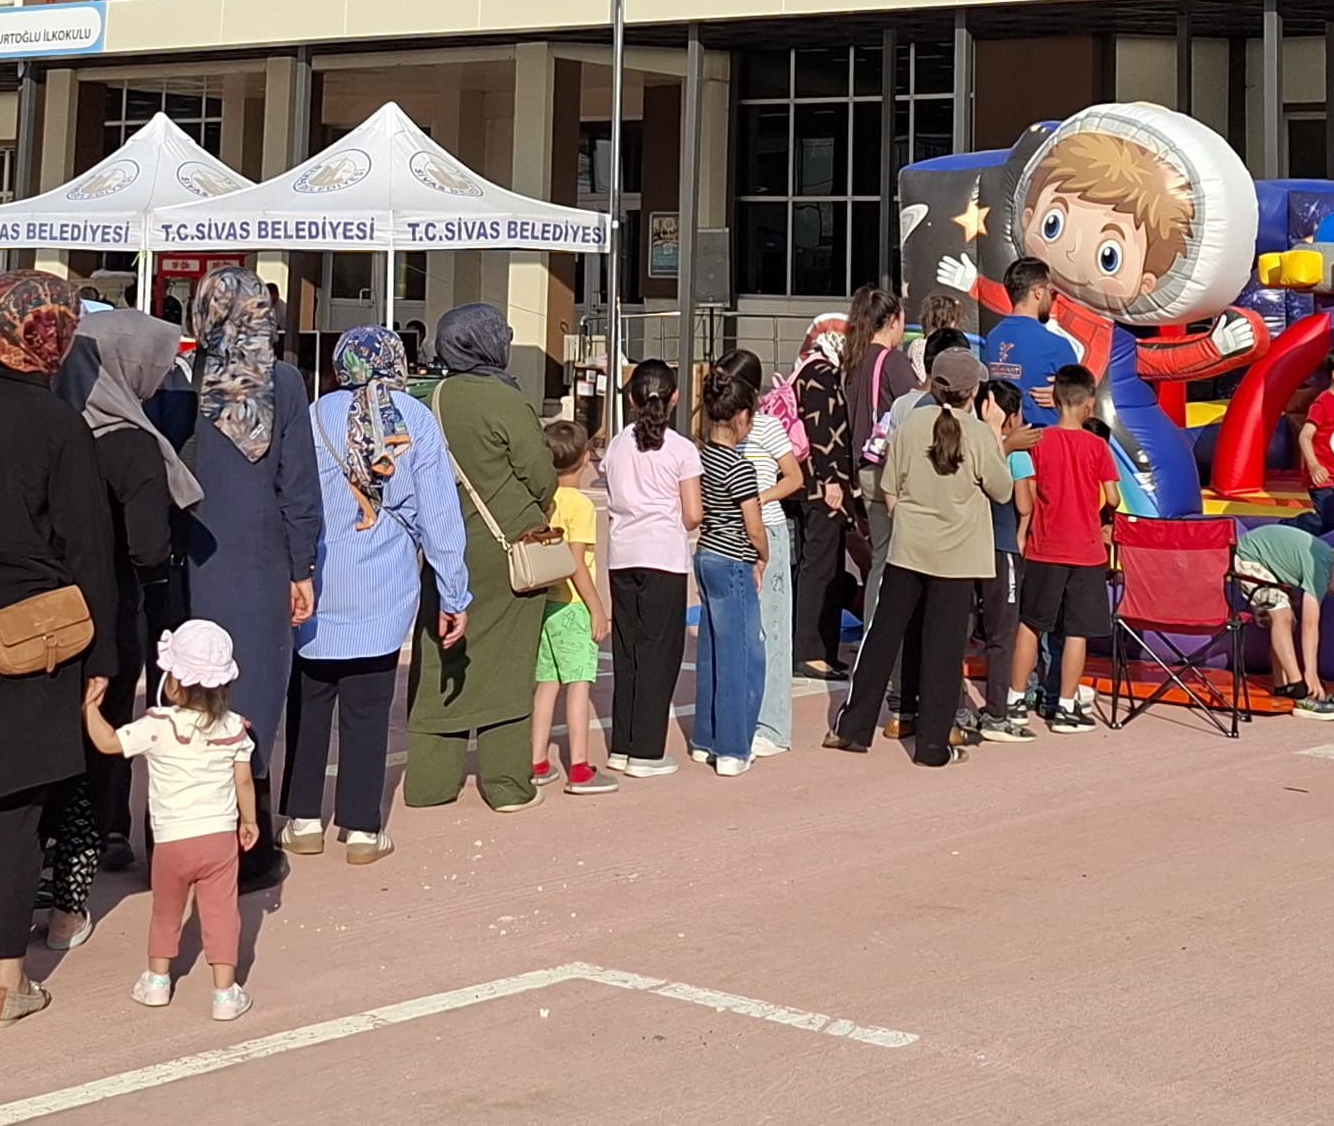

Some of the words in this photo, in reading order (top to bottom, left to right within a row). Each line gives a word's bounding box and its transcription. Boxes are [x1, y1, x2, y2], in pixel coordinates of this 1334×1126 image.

[43, 27, 92, 42] İLKOKULU
[25, 220, 130, 243] BELEDİYESİ
[256, 216, 375, 241] BELEDİYESİ
[506, 219, 607, 245] BELEDİYESİ
